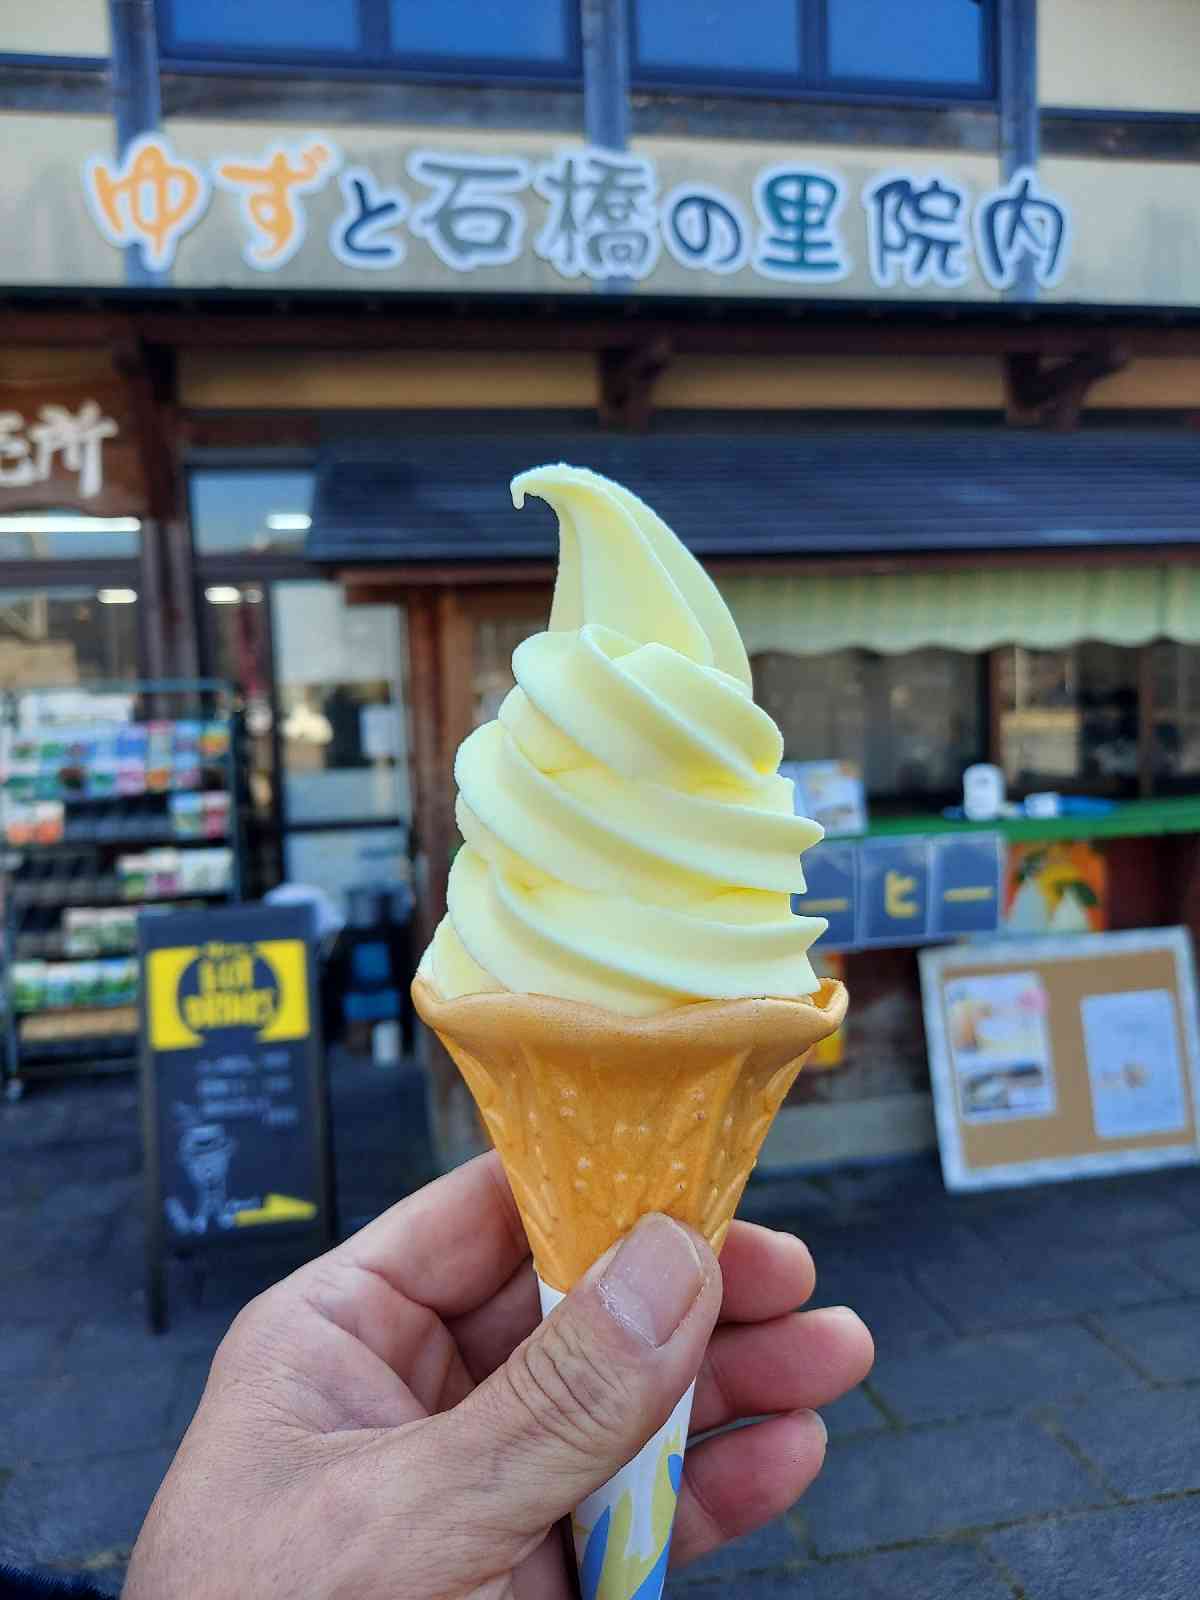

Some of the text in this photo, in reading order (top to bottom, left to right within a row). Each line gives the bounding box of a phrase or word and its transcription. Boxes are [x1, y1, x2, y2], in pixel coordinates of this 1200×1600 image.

[90, 142, 1064, 280] ゆずと石橋の里院内
